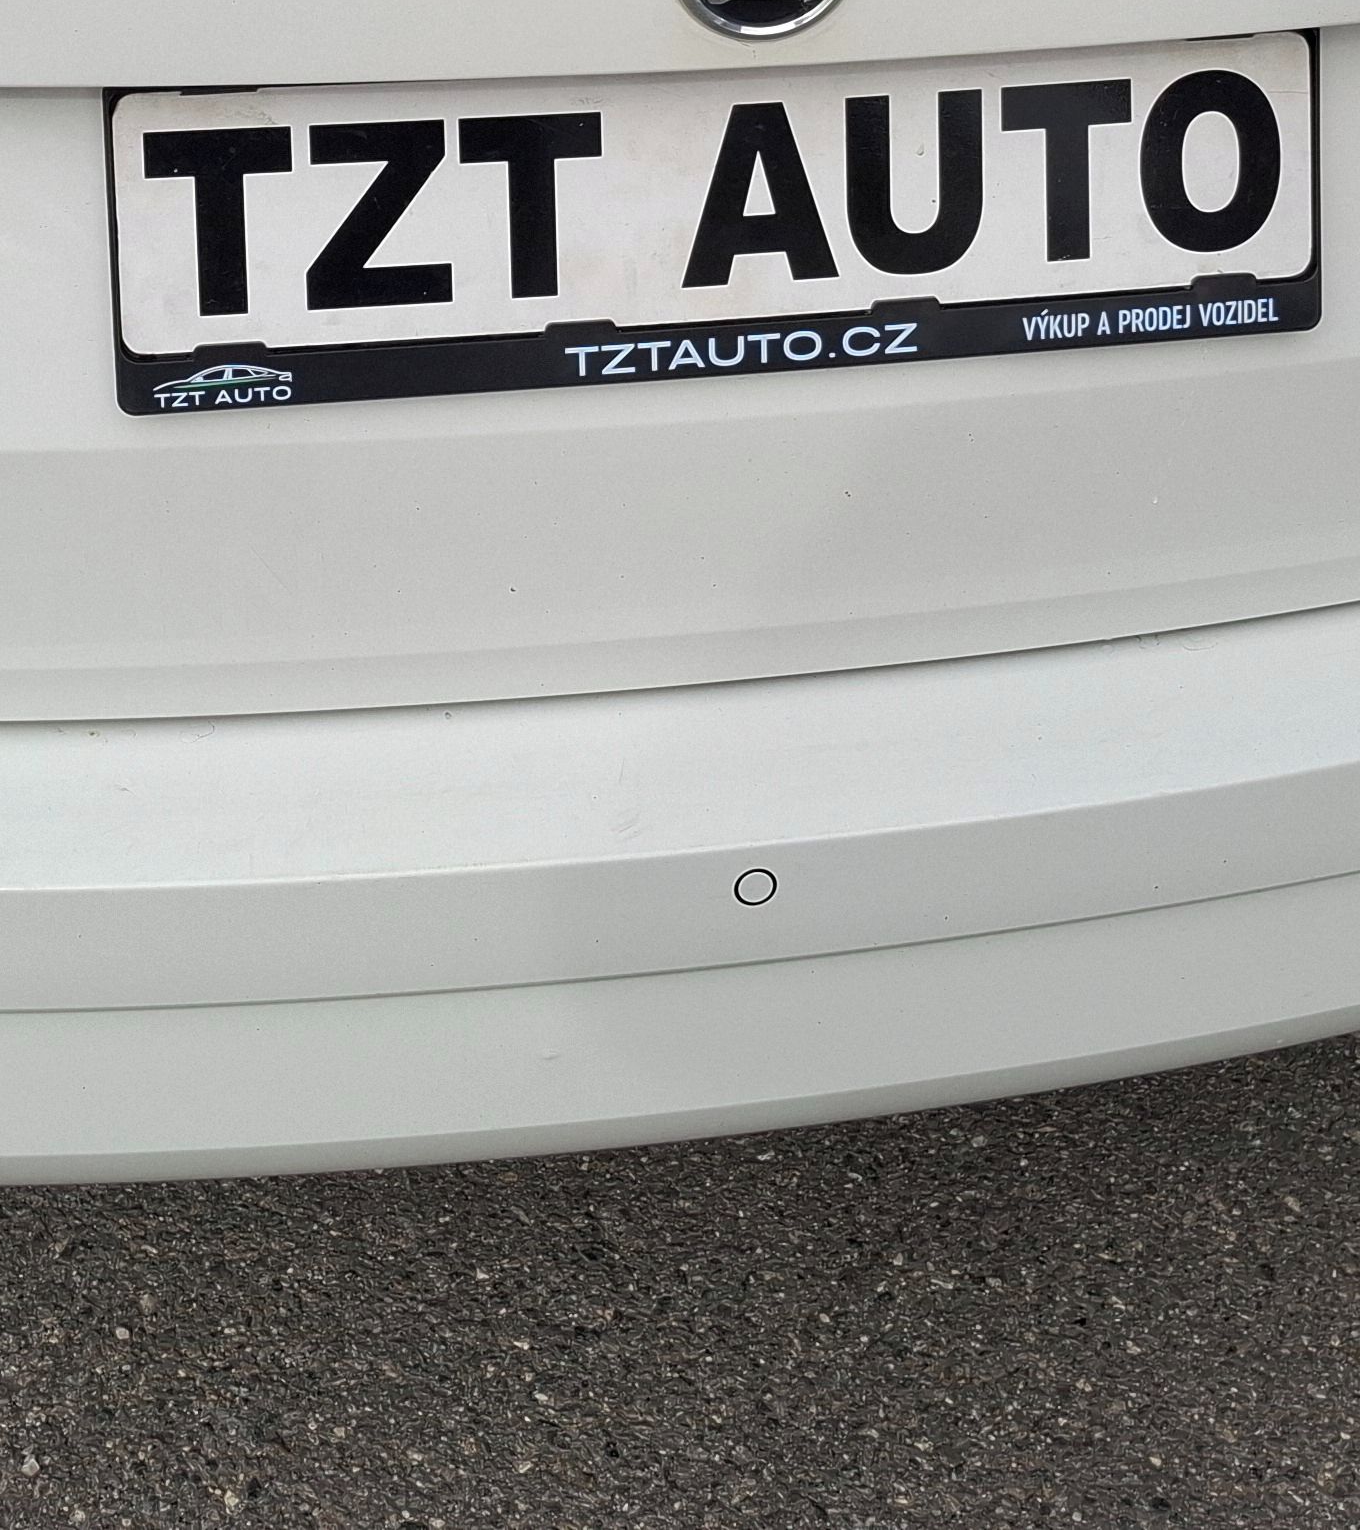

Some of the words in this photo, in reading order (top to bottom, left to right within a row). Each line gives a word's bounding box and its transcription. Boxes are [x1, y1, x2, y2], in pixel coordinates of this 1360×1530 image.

[142, 110, 603, 318] TZT
[681, 68, 1283, 290] AUTO
[1022, 308, 1090, 341] VÝKUP
[1096, 311, 1111, 336] A
[1118, 305, 1191, 334] PRODEJ
[1198, 297, 1279, 327] VOZIDEL
[564, 322, 918, 377] TZTAUTO.CZ
[153, 390, 206, 409] TZT
[214, 385, 292, 405] AUTO
